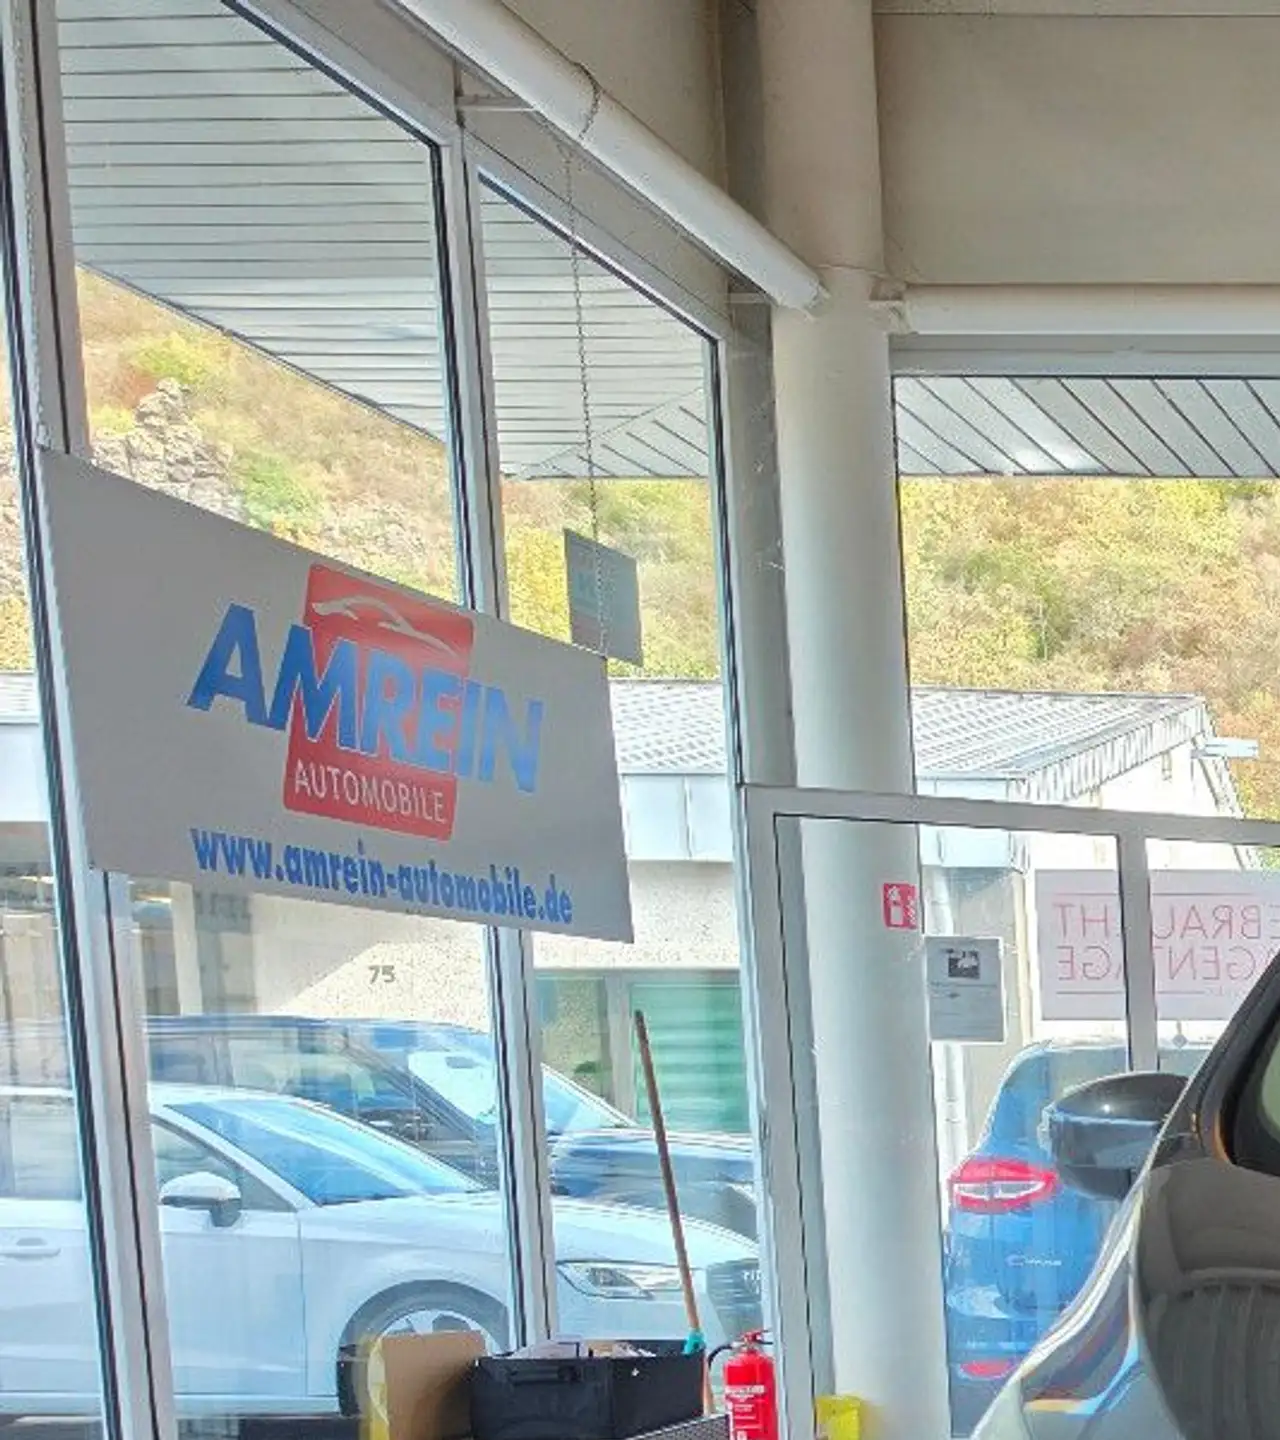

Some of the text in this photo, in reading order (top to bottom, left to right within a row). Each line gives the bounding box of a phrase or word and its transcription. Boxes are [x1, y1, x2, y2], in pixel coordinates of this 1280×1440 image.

[185, 602, 544, 793] AMREIN
[294, 759, 448, 824] AUTOMOBILE
[190, 828, 574, 925] www.amrein-automobile.de
[368, 964, 396, 985] 75
